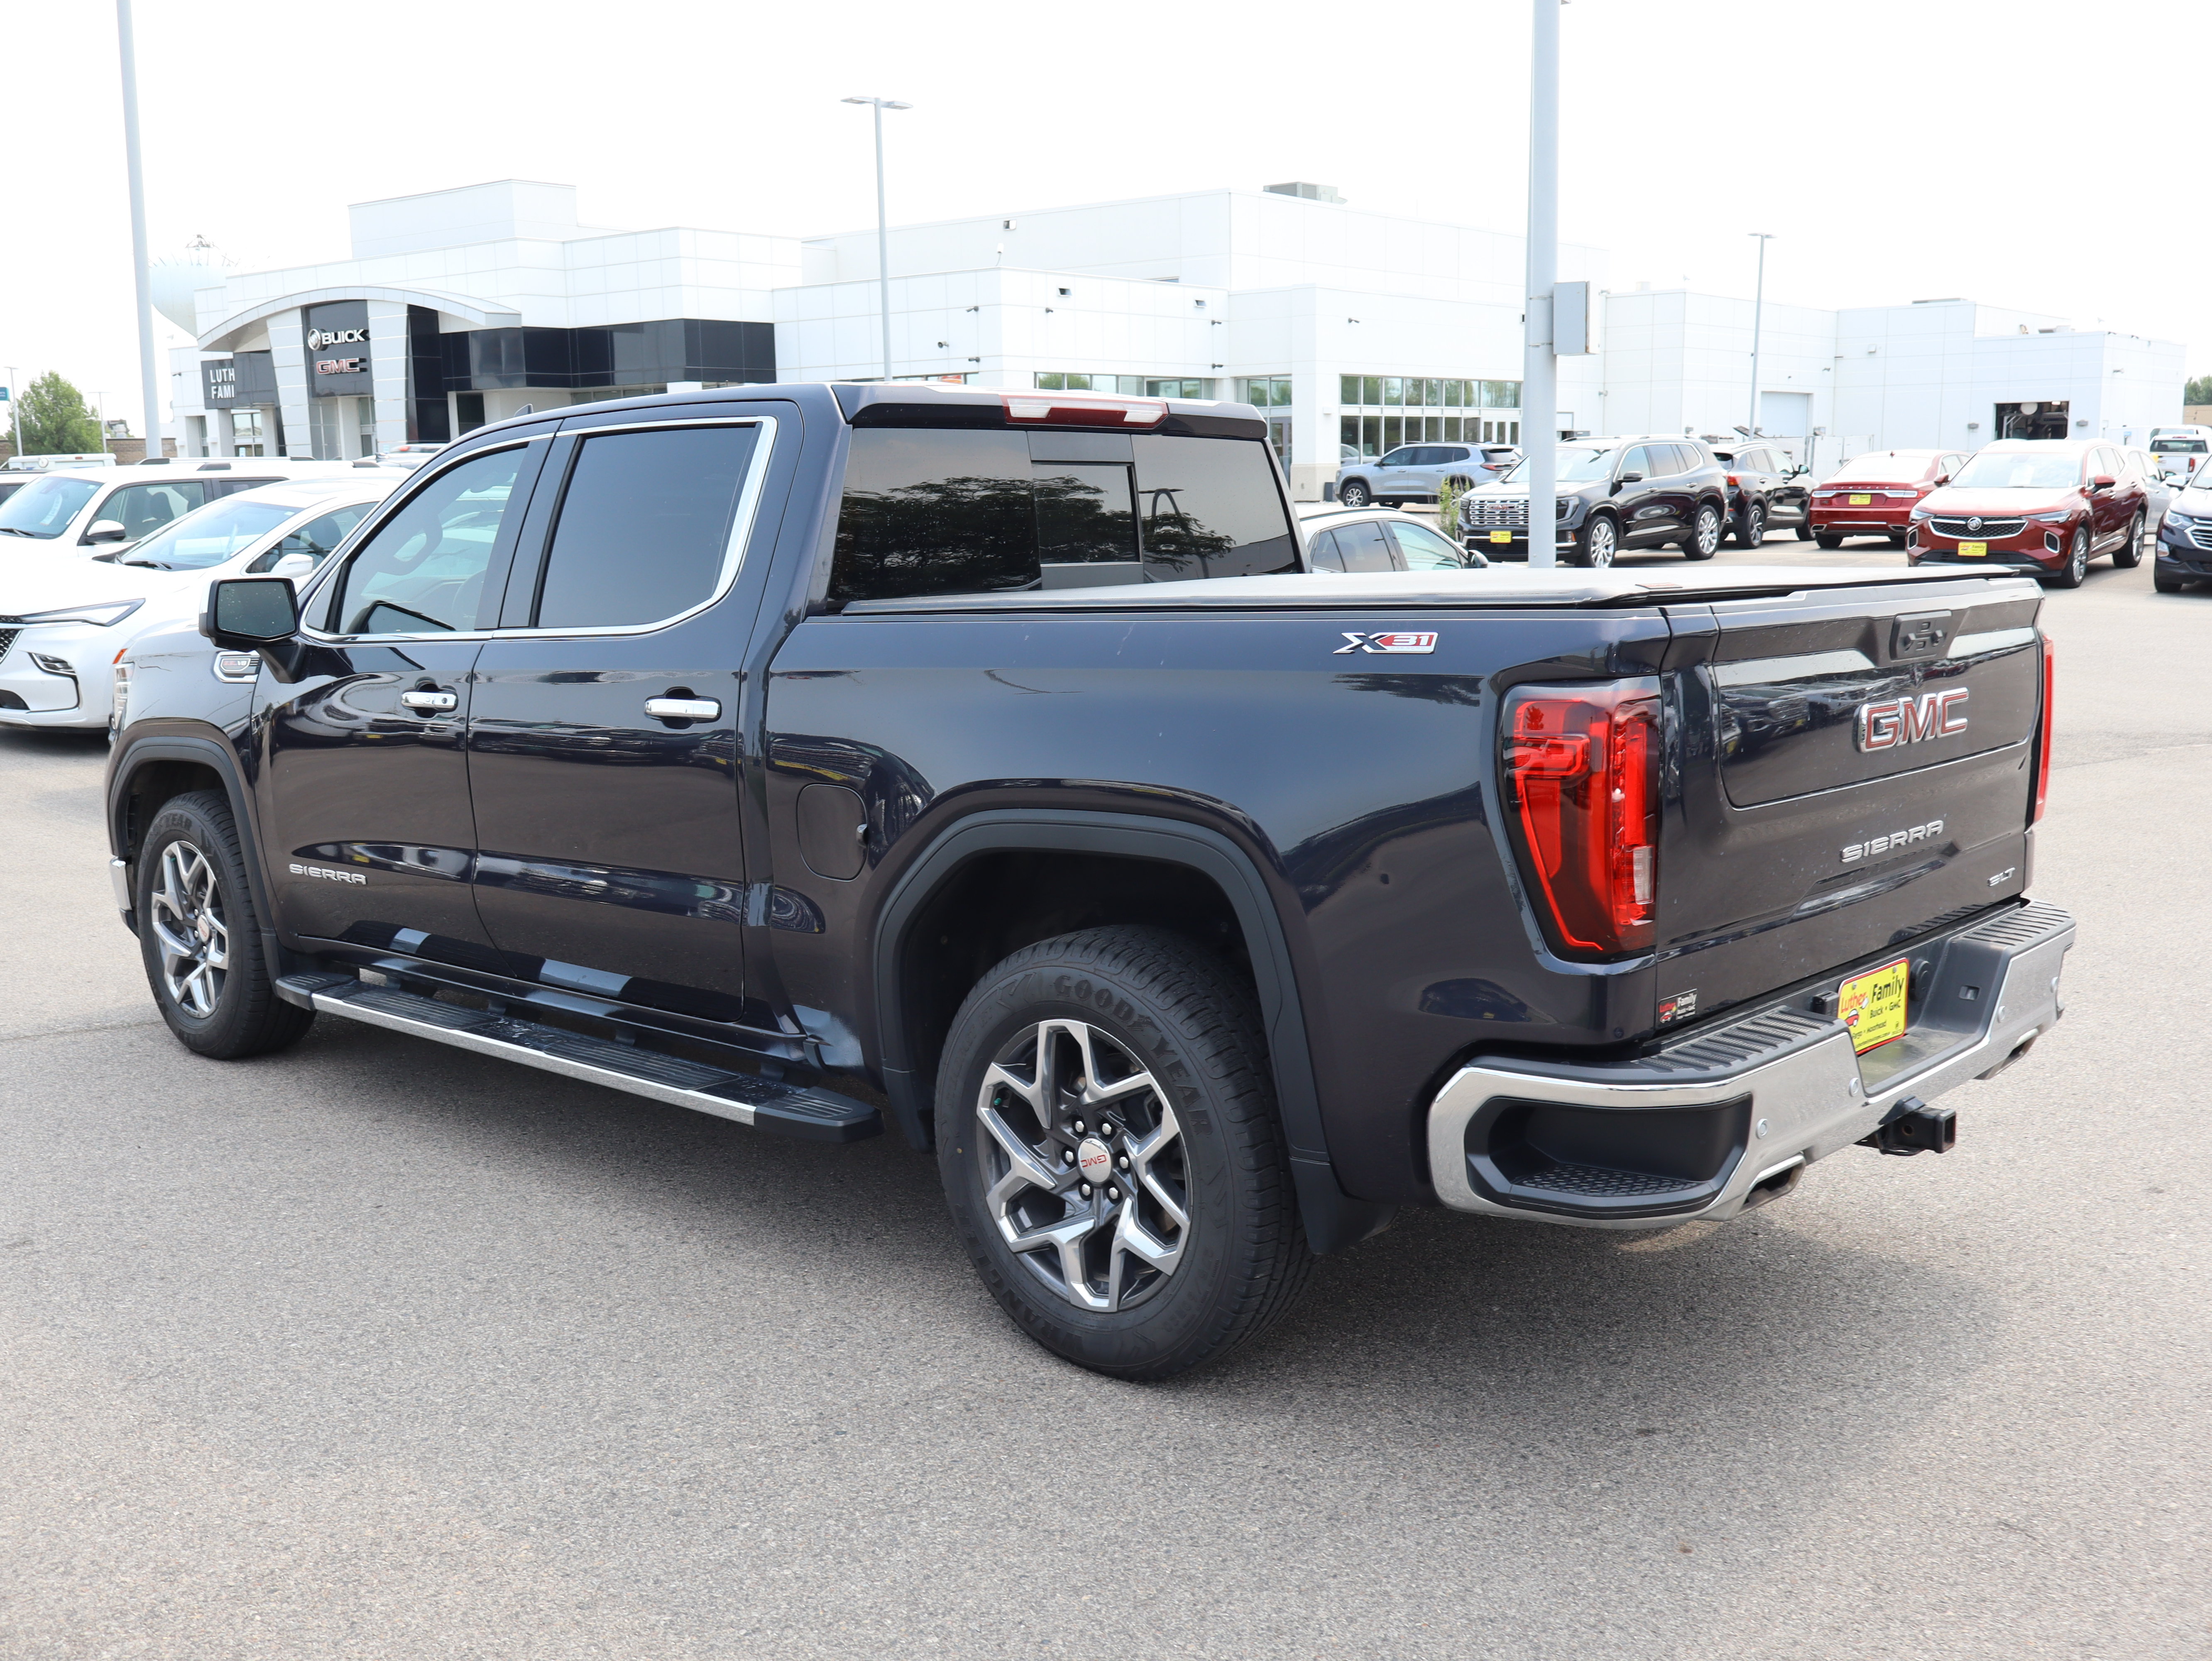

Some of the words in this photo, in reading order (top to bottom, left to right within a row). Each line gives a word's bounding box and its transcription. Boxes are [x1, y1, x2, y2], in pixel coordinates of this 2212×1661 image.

[322, 329, 365, 345] BUICK
[209, 368, 235, 383] LUTH
[316, 358, 360, 375] GMC
[211, 385, 235, 399] FAMI
[1852, 687, 1970, 753] GMC
[1841, 820, 1944, 862] SIERRA
[289, 864, 367, 885] SIERRA
[1988, 867, 2016, 886] SLT
[1871, 975, 1905, 1003] Family
[1678, 993, 1697, 1007] Family
[1840, 991, 1867, 1014] Luther
[1870, 1006, 1884, 1019] Buick
[1889, 999, 1901, 1011] GMC
[1054, 975, 1213, 1135] GOODYEAR
[1080, 1154, 1107, 1168] GMC
[954, 1204, 1086, 1355] WRANGLER
